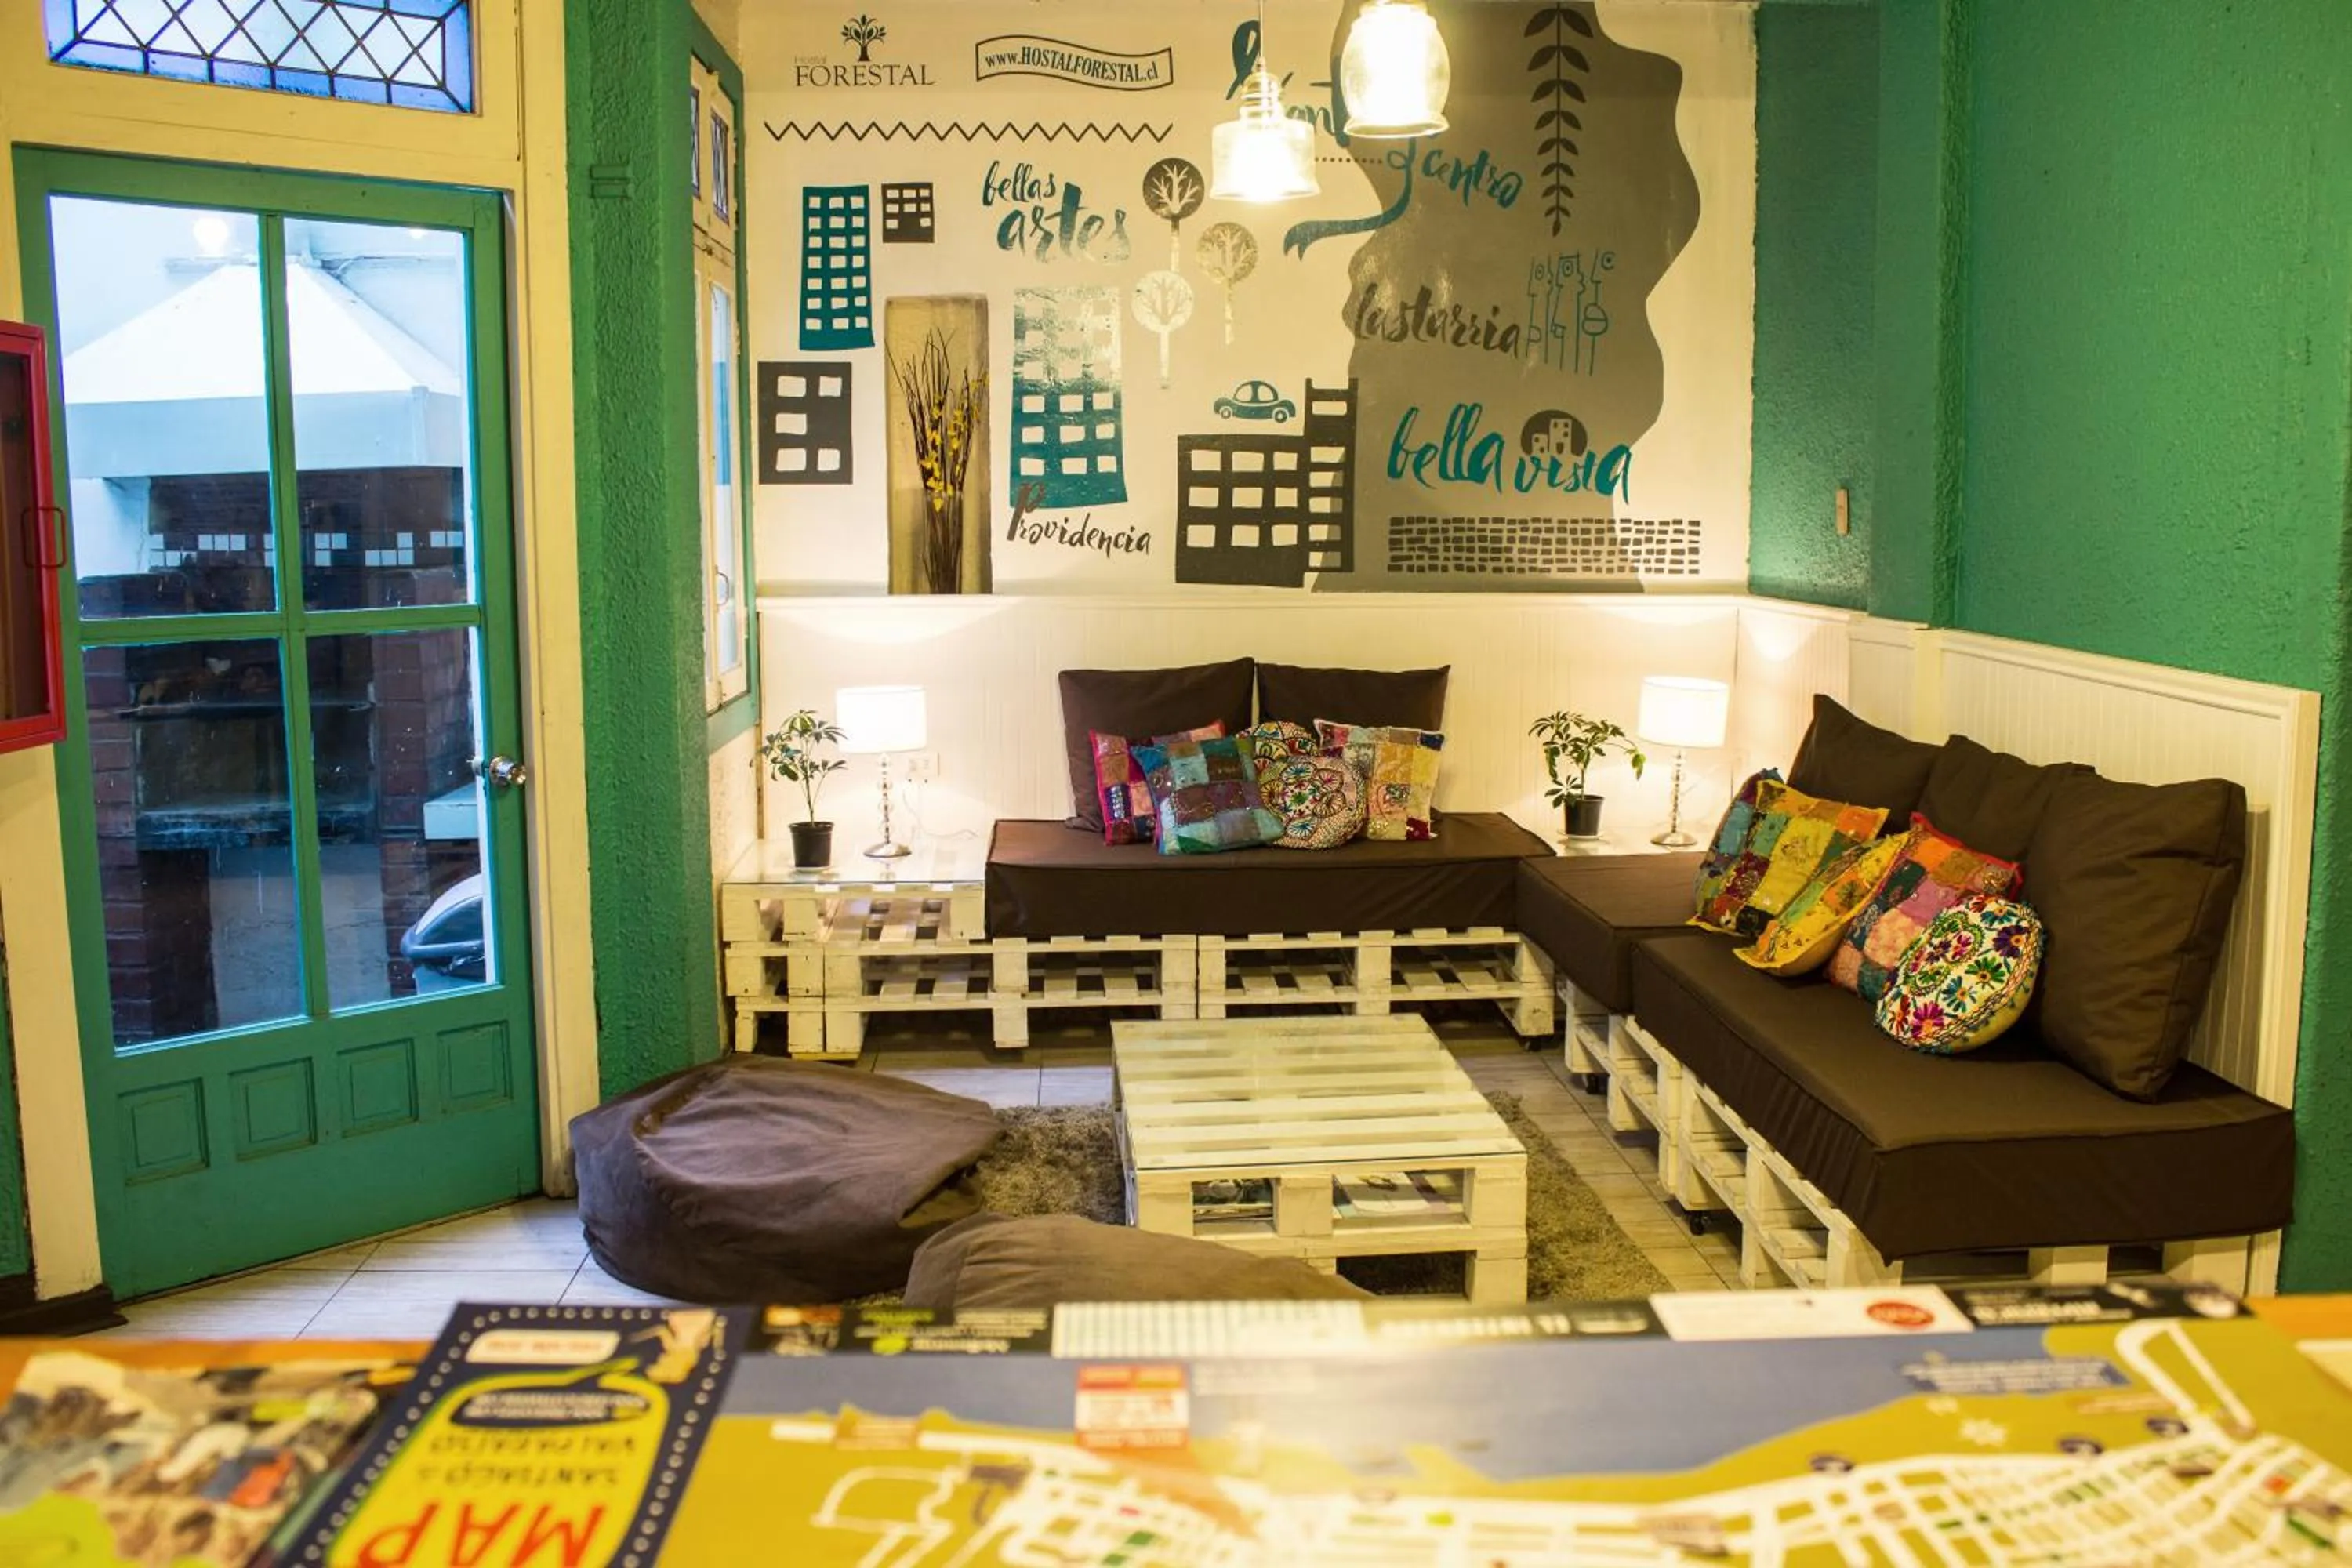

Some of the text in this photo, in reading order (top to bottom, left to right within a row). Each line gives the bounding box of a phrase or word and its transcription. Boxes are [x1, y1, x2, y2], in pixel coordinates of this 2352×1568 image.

[795, 64, 940, 87] FORESTAL
[984, 45, 1159, 82] www.HOSTALFORESTAL.cl
[982, 160, 1056, 206] bellas
[996, 181, 1131, 264] artes
[1387, 402, 1632, 506] bella vista
[1007, 481, 1152, 559] Providencia
[358, 1501, 607, 1568] MAP
